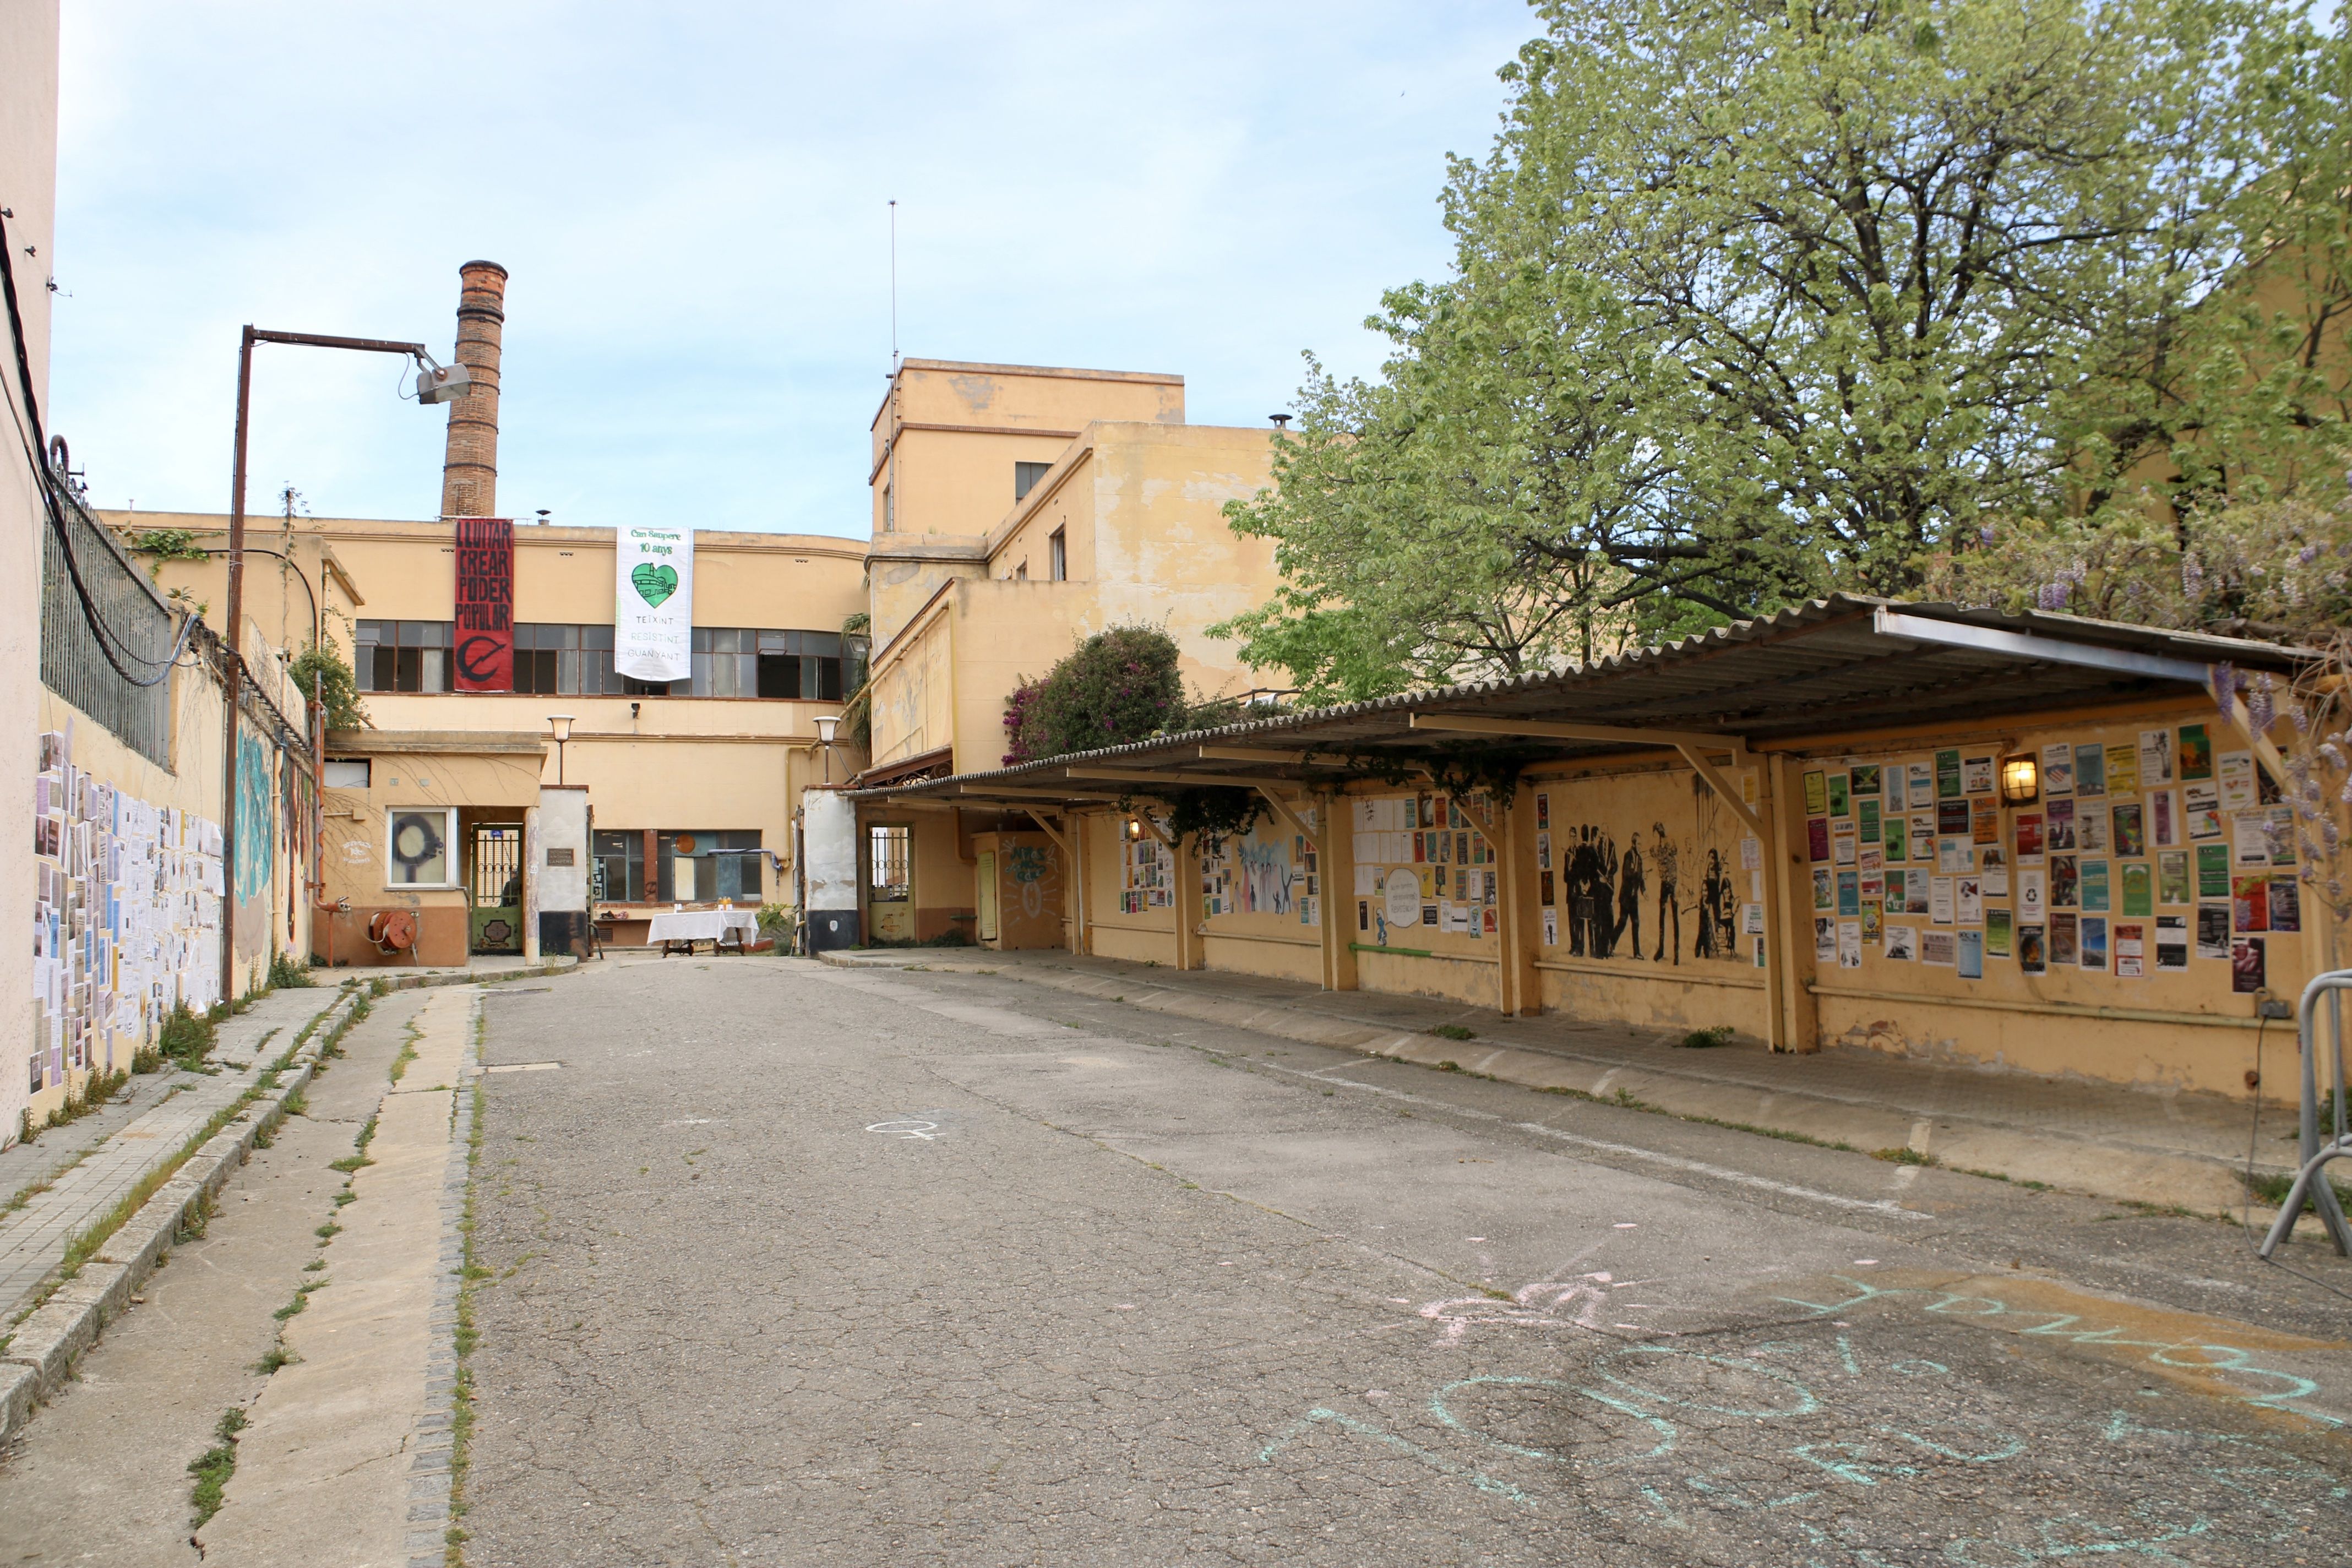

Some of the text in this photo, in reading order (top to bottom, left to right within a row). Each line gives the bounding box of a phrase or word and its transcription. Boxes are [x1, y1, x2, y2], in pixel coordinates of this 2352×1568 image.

[630, 529, 681, 540] Can Sanpere
[640, 542, 673, 556] 10 anys
[459, 550, 509, 576] CREAR
[459, 576, 511, 603] PODER
[455, 603, 510, 631] POPULAR
[628, 649, 680, 661] GUANYANT
[1258, 1334, 1949, 1505] 100%
